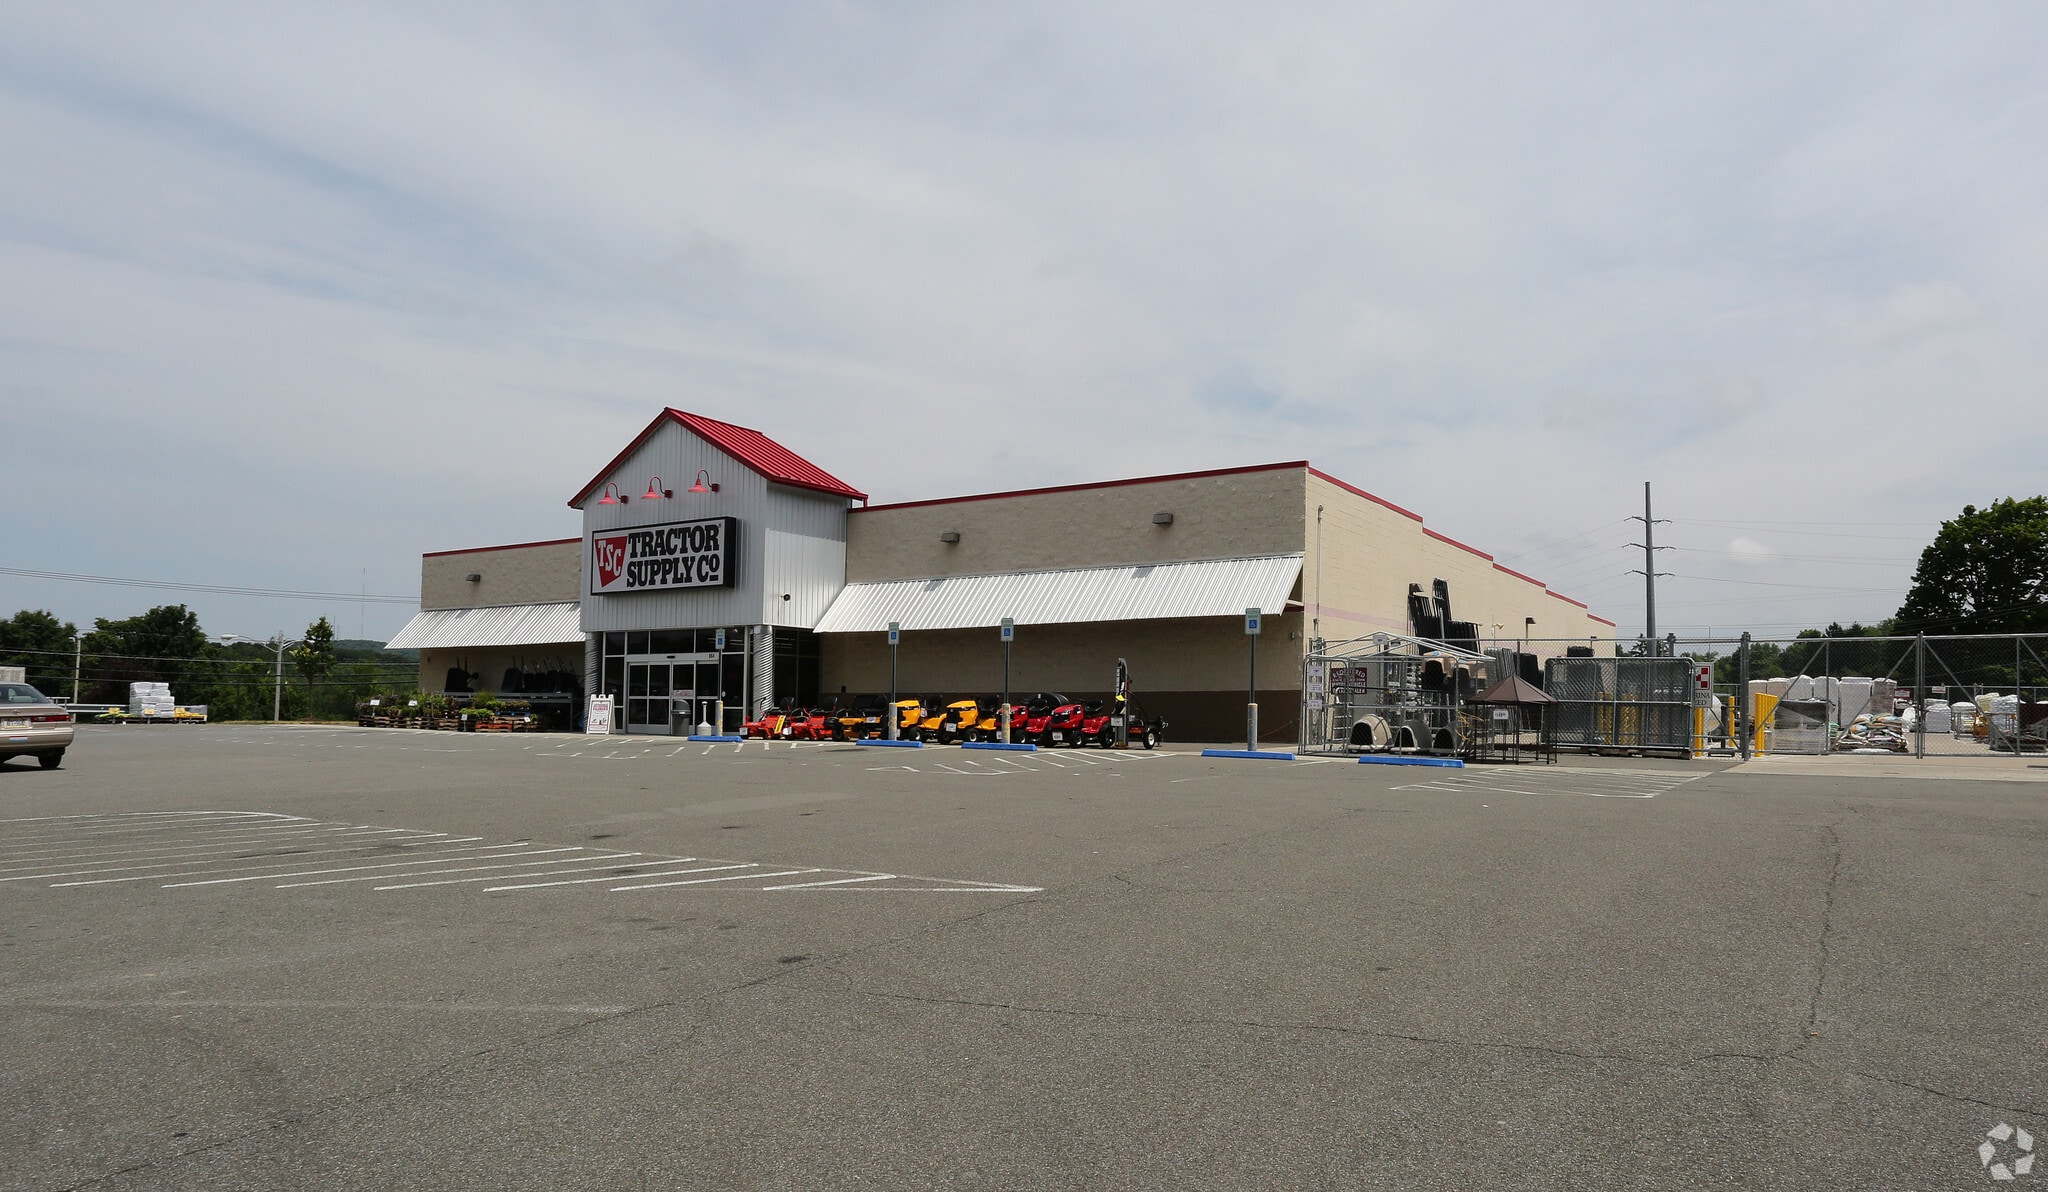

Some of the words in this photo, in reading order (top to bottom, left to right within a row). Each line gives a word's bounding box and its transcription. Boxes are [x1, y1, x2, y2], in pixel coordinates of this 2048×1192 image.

[598, 539, 622, 577] TSC
[628, 524, 720, 558] TRACTOR
[626, 556, 696, 588] SUPPLY
